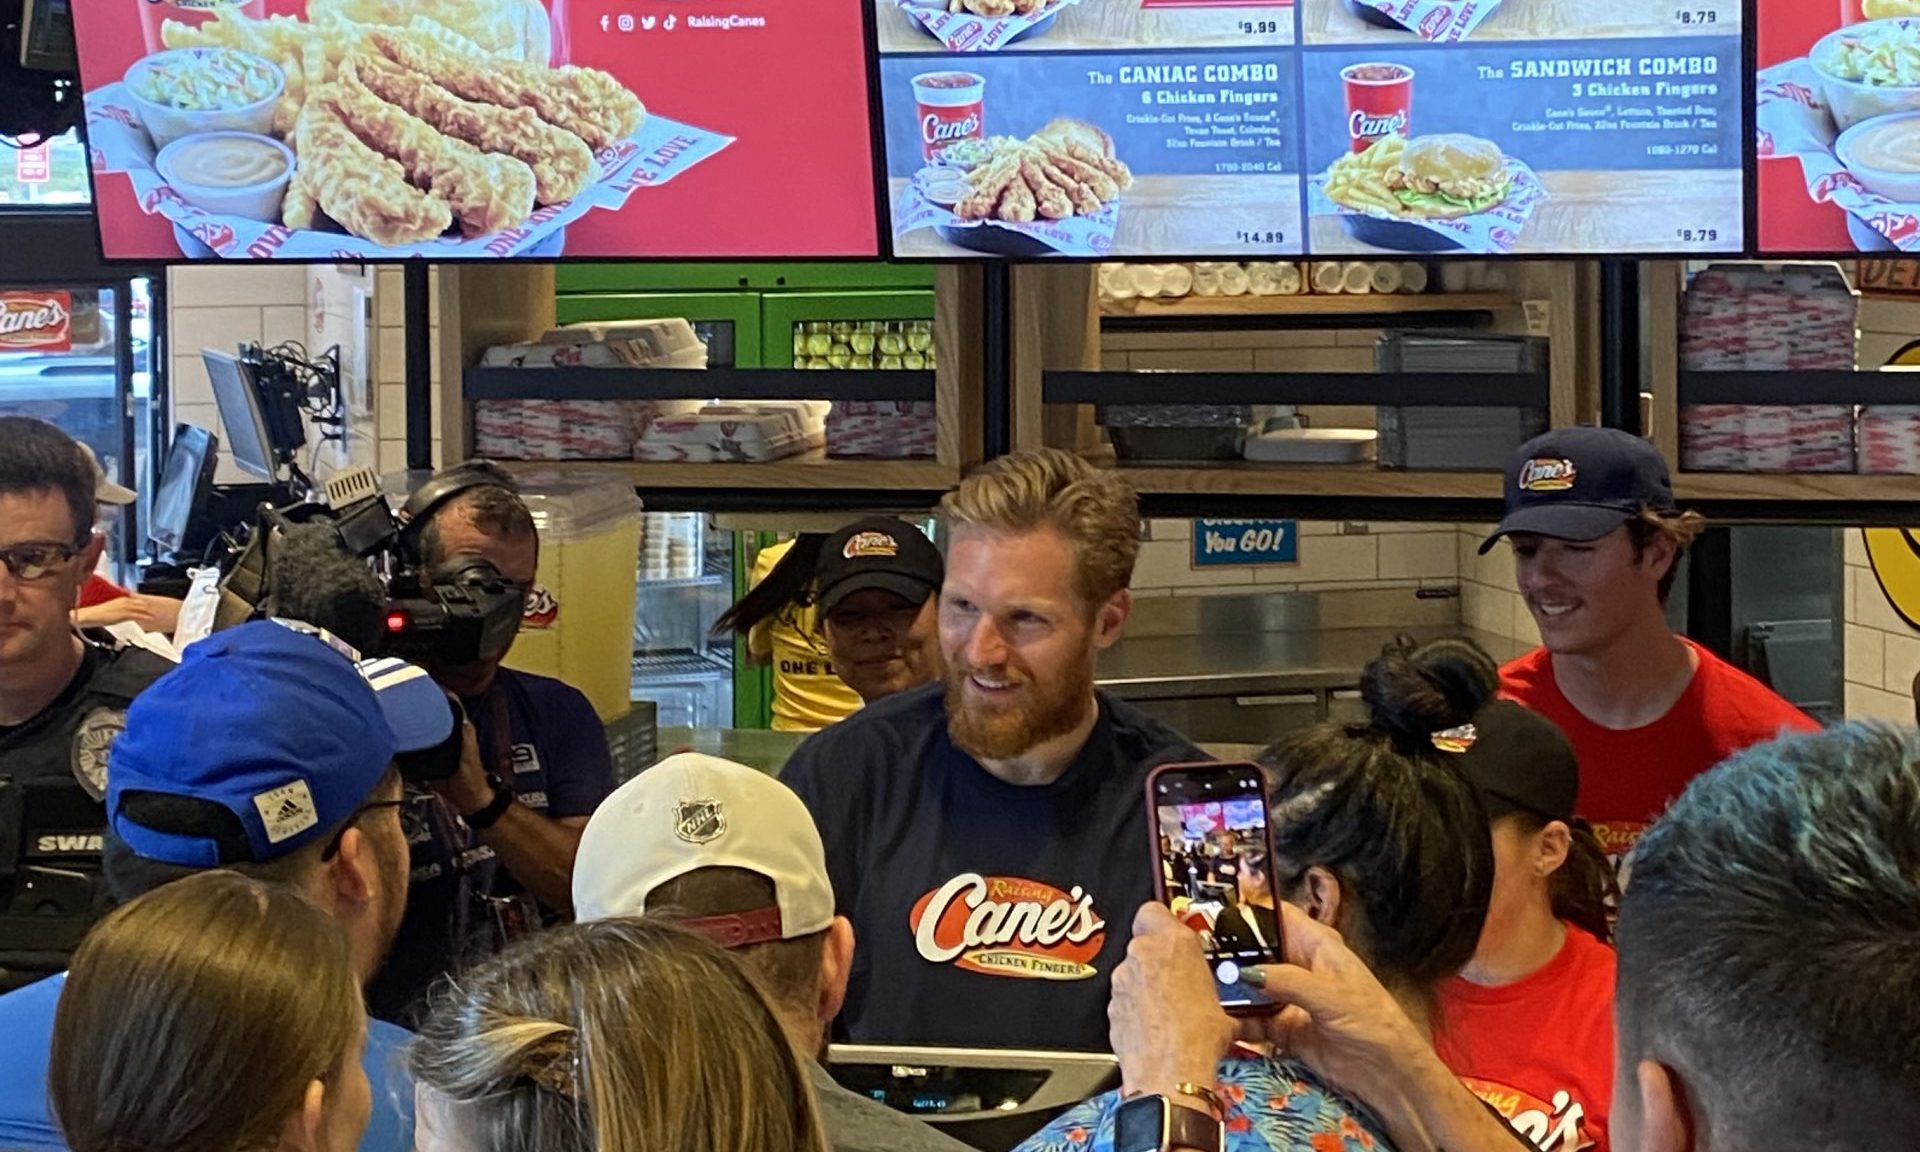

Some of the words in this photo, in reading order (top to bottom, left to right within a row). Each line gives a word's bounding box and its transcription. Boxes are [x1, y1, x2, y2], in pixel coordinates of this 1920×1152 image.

[687, 15, 765, 29] RaisingCanes
[1675, 10, 1716, 24] $8.79
[1088, 71, 1113, 85] The
[1119, 65, 1198, 84] CANIAC
[1204, 63, 1278, 83] COMBO
[1477, 66, 1504, 79] The
[1510, 58, 1632, 79] SANDWICH
[1639, 56, 1718, 76] COMBO
[1141, 91, 1152, 104] 6
[1157, 90, 1215, 104] Chicken
[1220, 89, 1278, 105] Fingers
[1572, 84, 1582, 97] 3
[1587, 82, 1650, 97] Chicken
[1655, 81, 1718, 99] Fingers
[922, 111, 980, 144] Cane's
[1349, 109, 1407, 138] Cane's
[1701, 144, 1718, 154] Cal
[1236, 228, 1284, 244] $14.89
[1676, 228, 1717, 242] $8.79
[1205, 530, 1236, 555] You
[1240, 527, 1284, 553] GO!
[780, 660, 818, 675] ONE
[686, 806, 711, 834] NHL
[989, 879, 1054, 904] Raising
[916, 872, 1106, 962] Cane's
[977, 953, 1028, 969] CHICKEN
